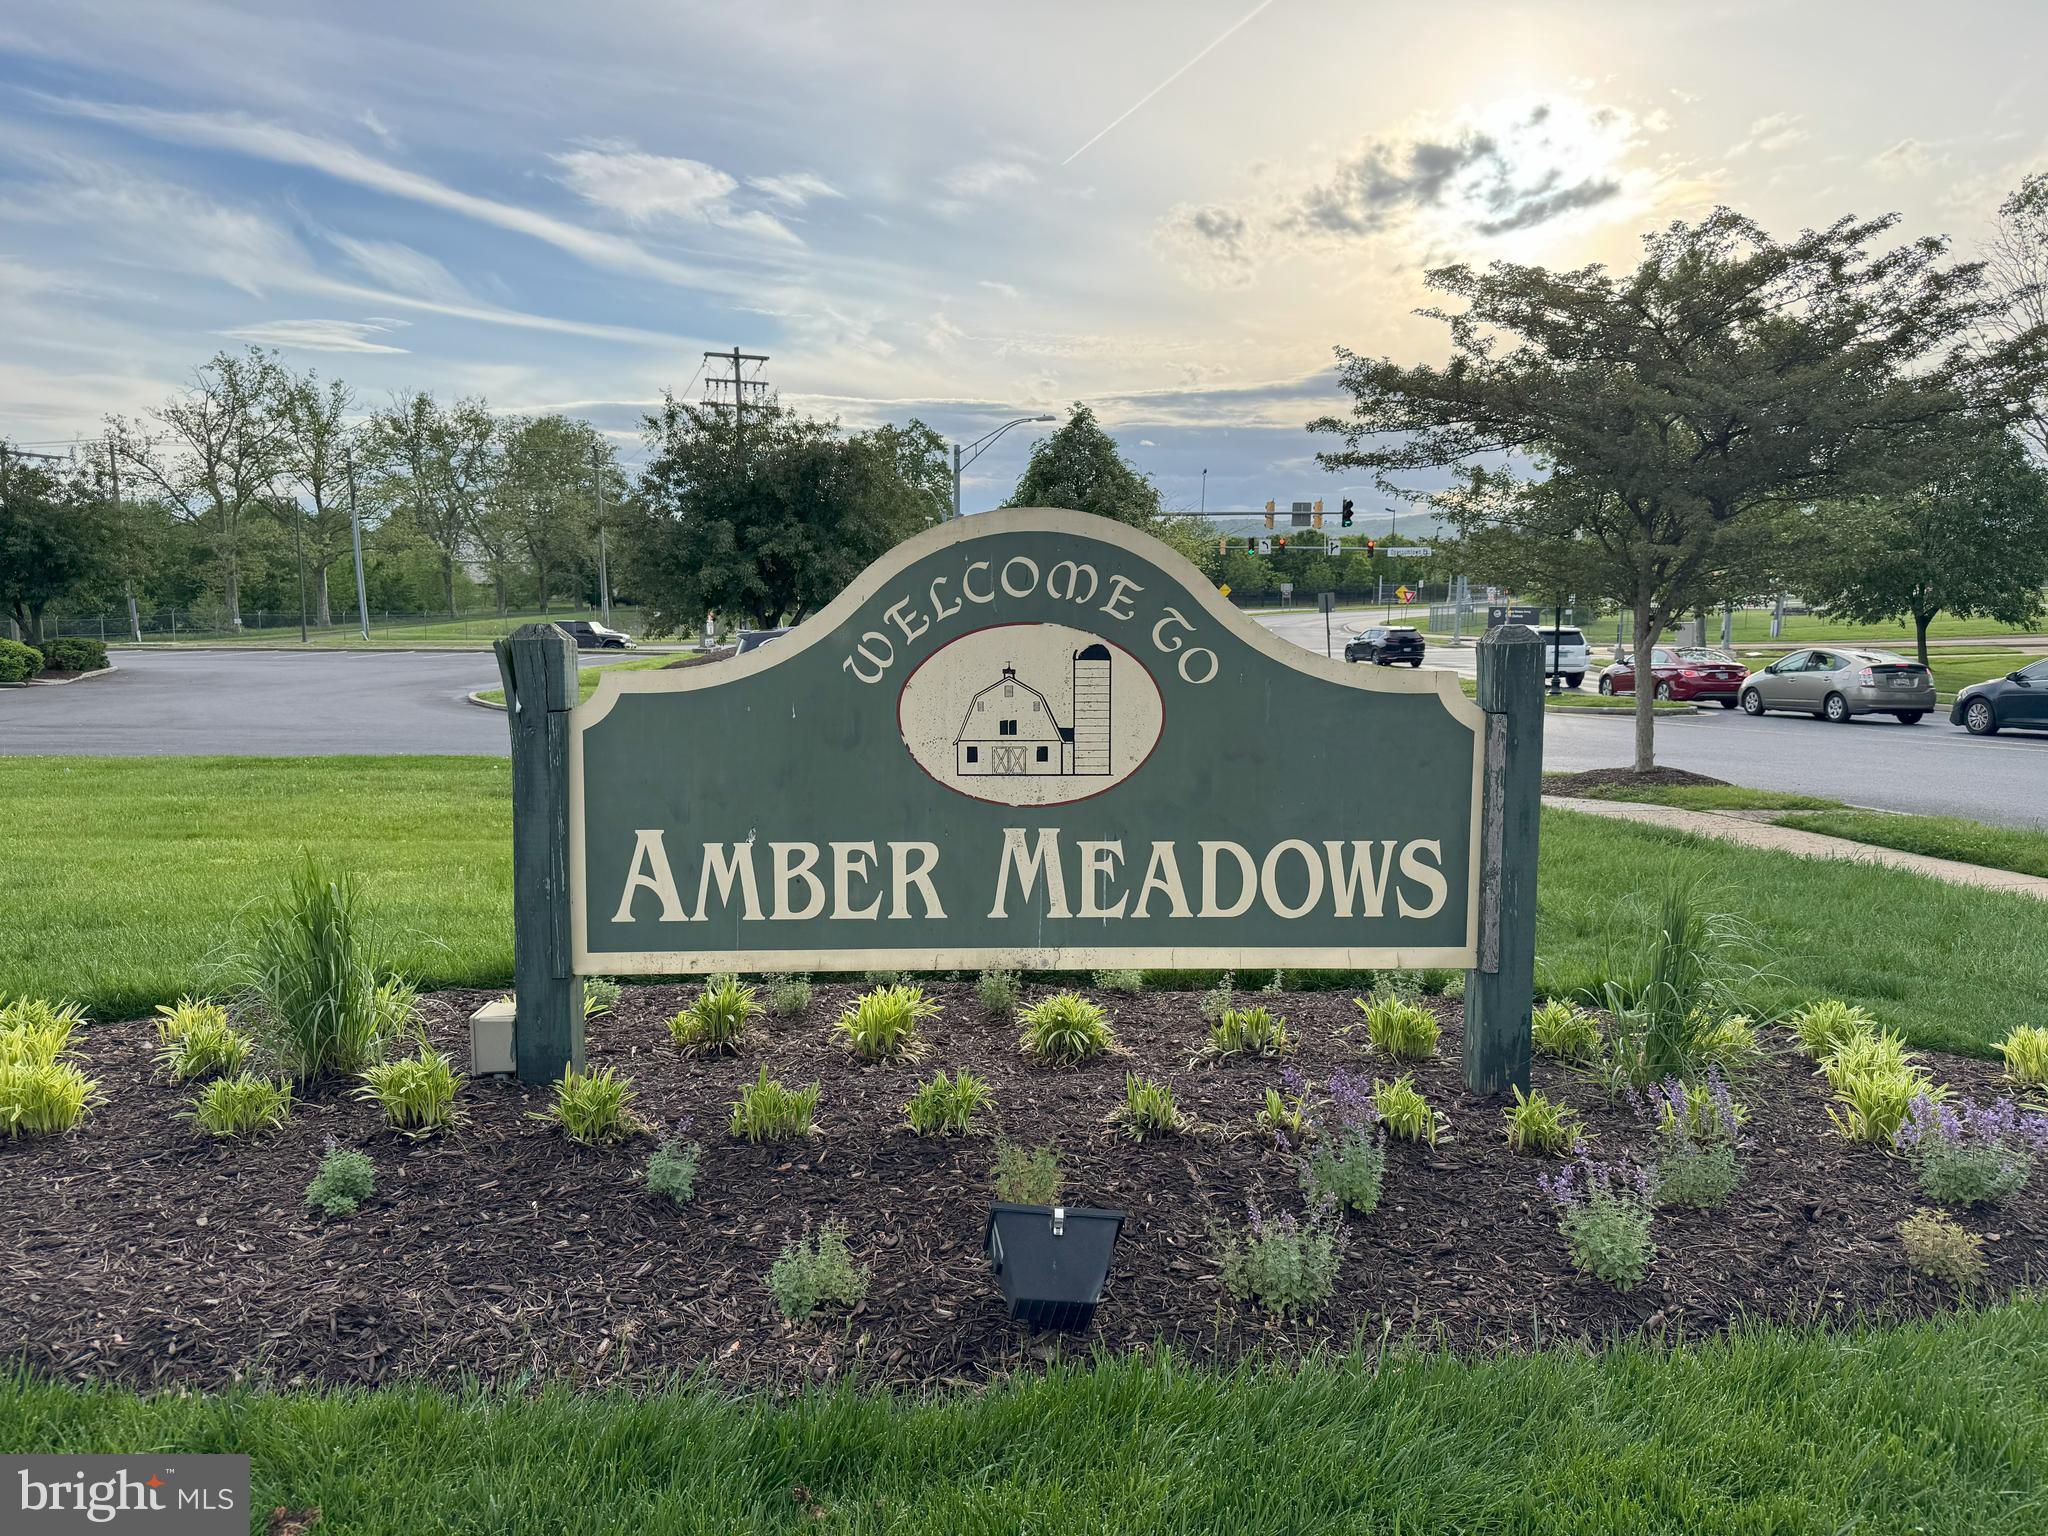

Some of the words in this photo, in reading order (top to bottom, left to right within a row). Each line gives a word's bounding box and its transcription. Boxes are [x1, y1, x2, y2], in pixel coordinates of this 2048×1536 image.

[842, 556, 1145, 684] WELCOME
[1152, 607, 1219, 684] TO
[610, 828, 948, 922] AMBER
[987, 827, 1448, 920] MEADOWS
